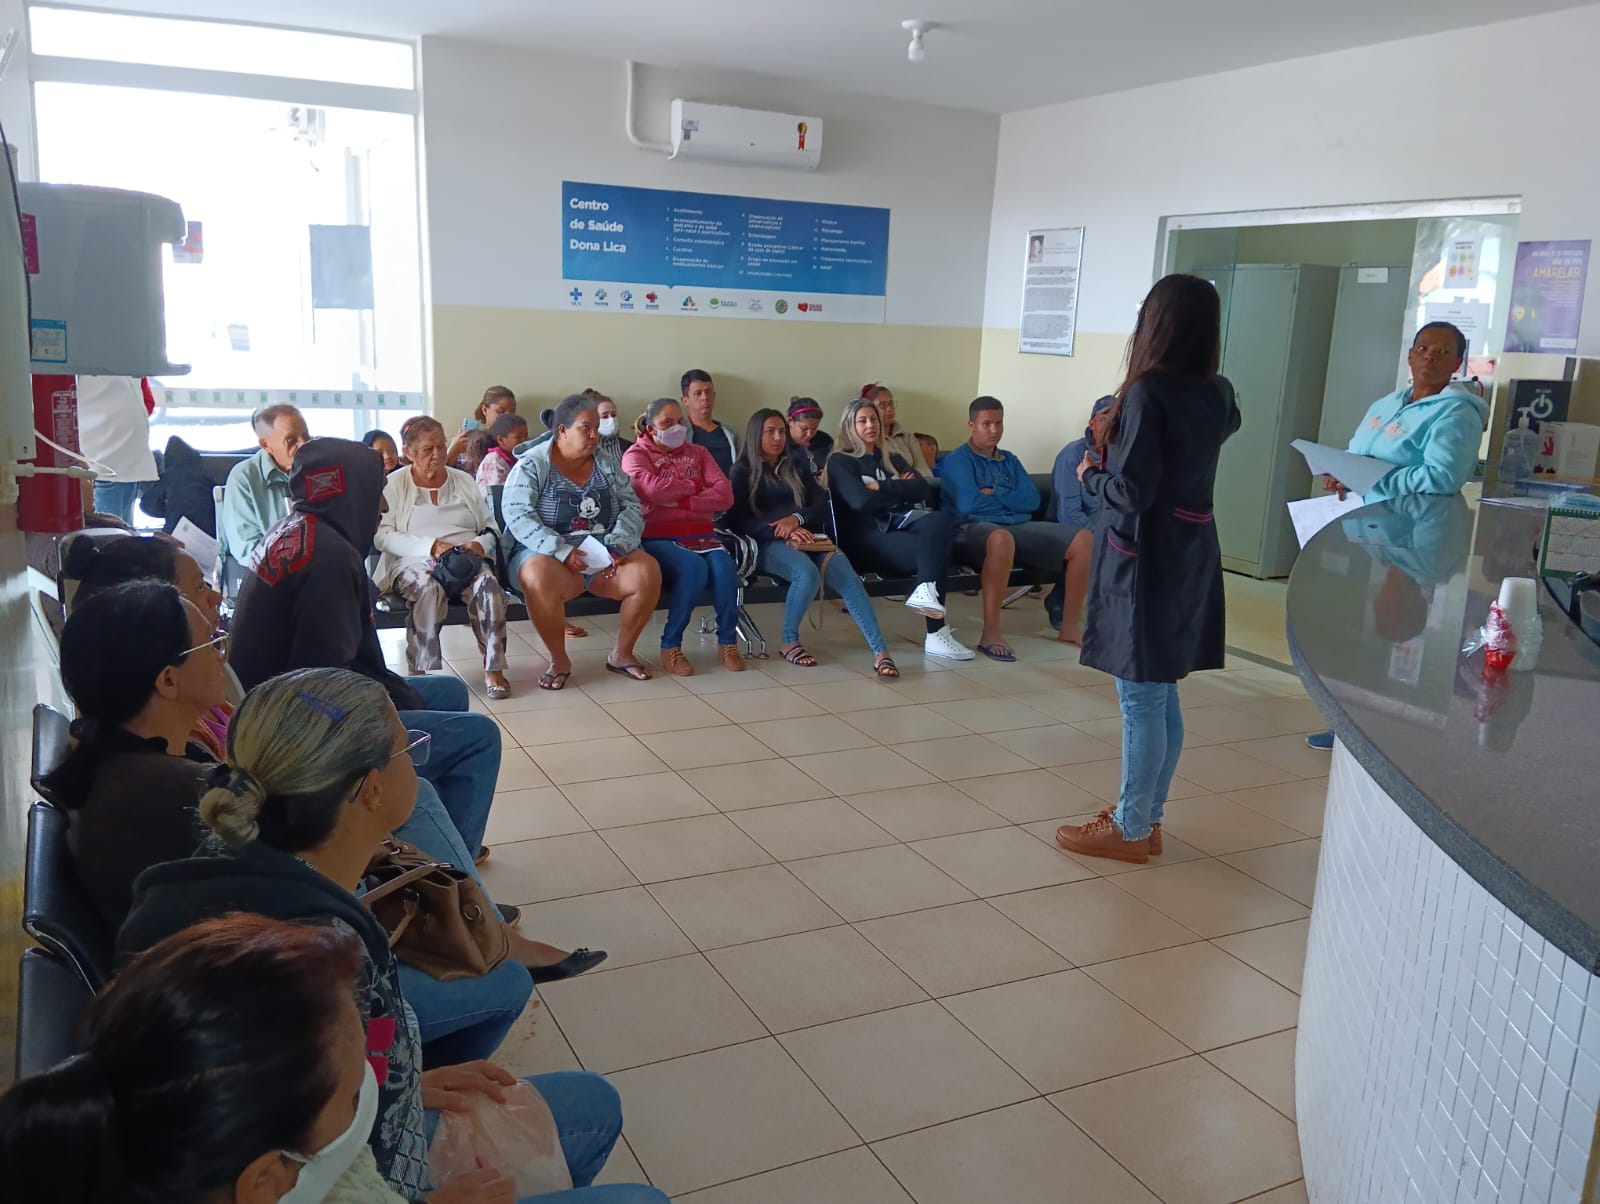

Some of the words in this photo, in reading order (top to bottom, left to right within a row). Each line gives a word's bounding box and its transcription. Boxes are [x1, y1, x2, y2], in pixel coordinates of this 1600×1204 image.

[570, 198, 609, 211] Centro
[570, 219, 585, 230] de
[588, 220, 624, 232] Saúde
[570, 239, 600, 251] Dona
[603, 241, 627, 253] Lica
